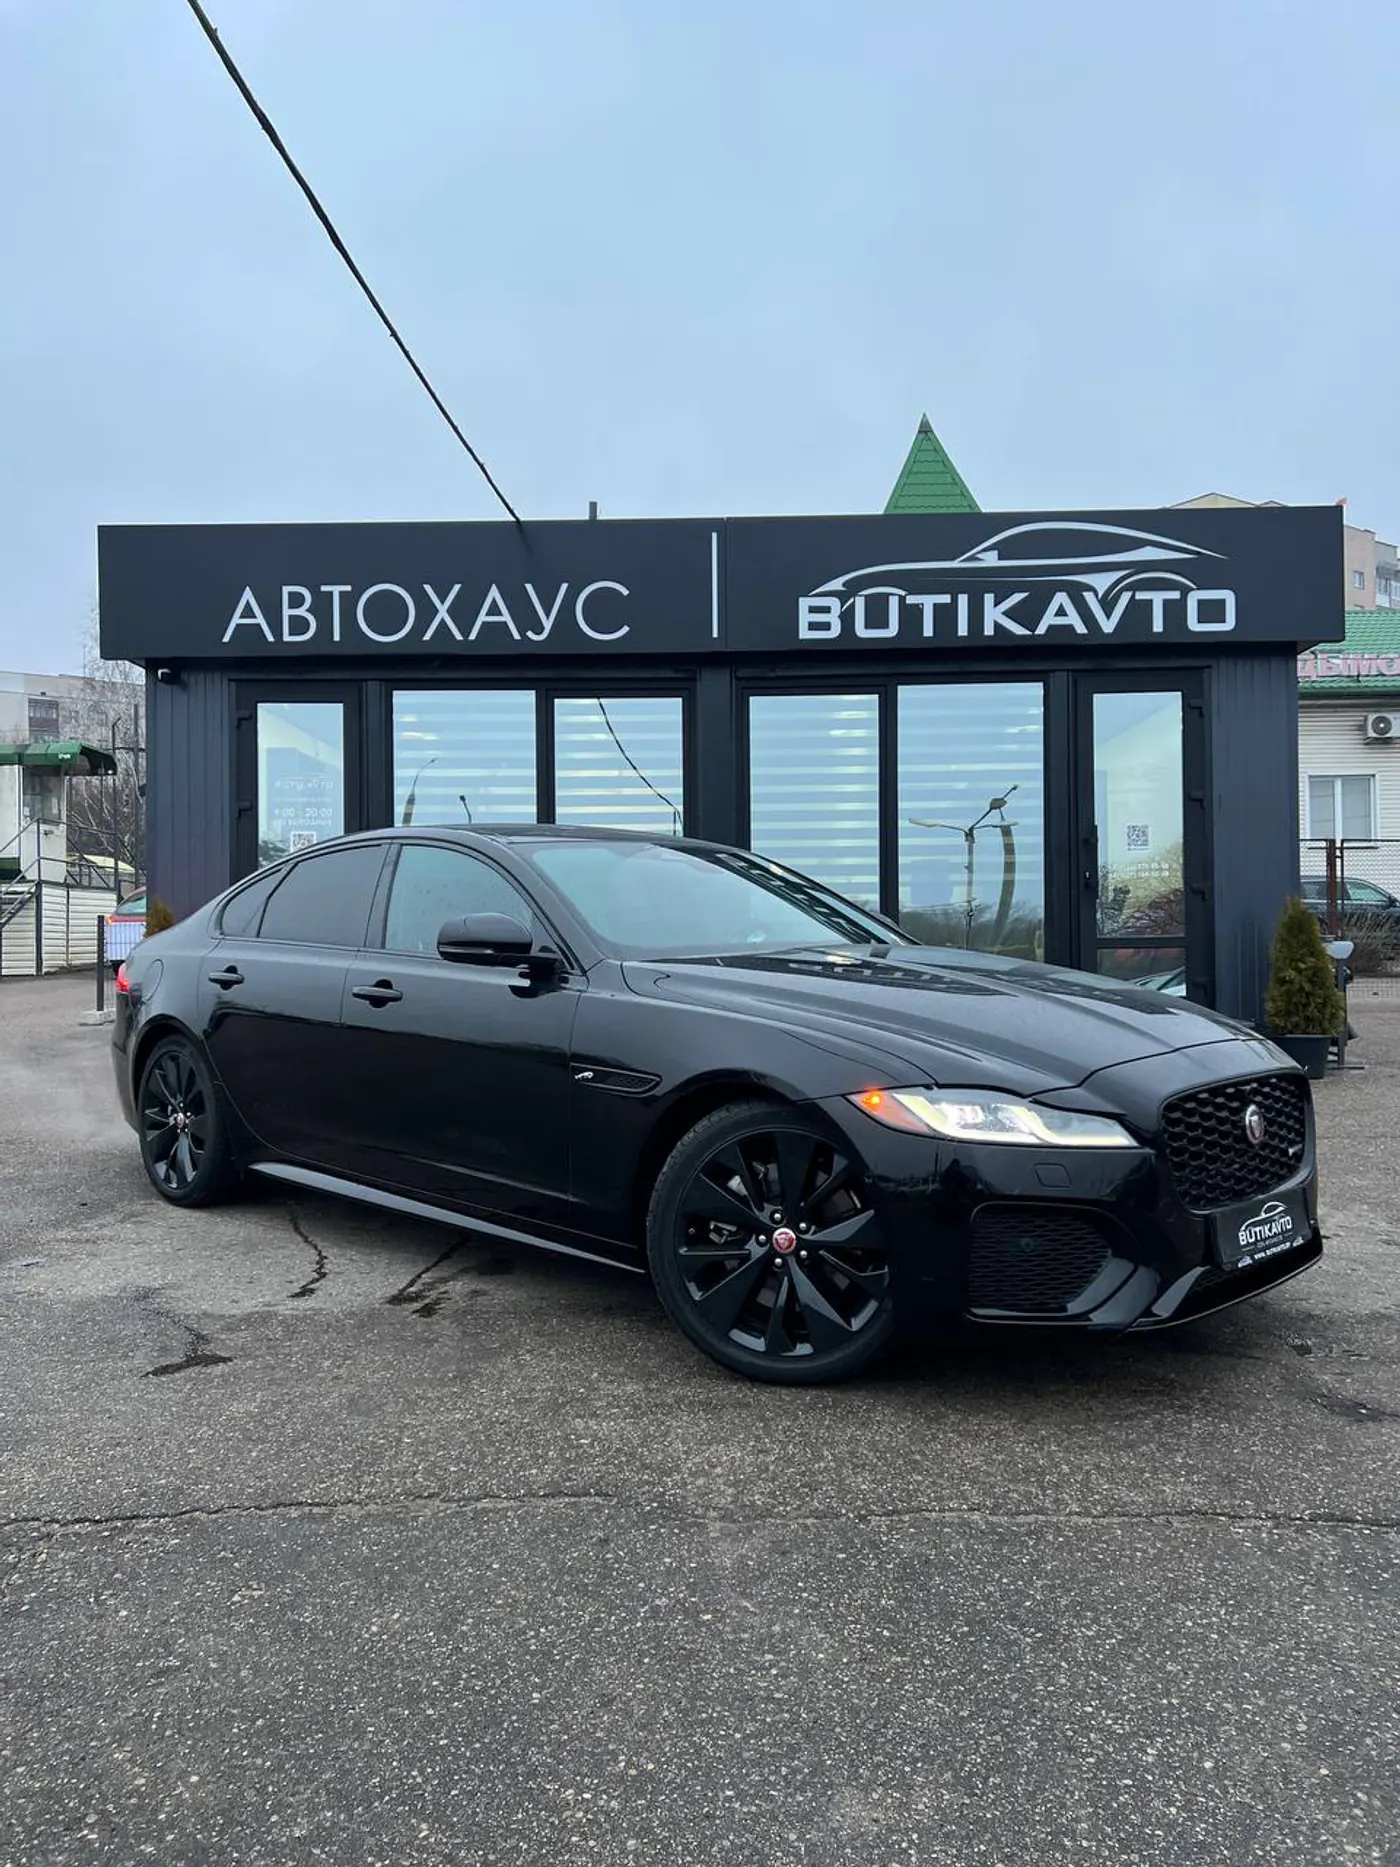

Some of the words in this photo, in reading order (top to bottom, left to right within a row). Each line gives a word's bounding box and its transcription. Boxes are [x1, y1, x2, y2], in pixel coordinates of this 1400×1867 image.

[222, 580, 630, 643] АВТОХАУС
[798, 588, 1236, 640] BUTIKAVTO
[1238, 1216, 1292, 1245] BUTIKAVTO
